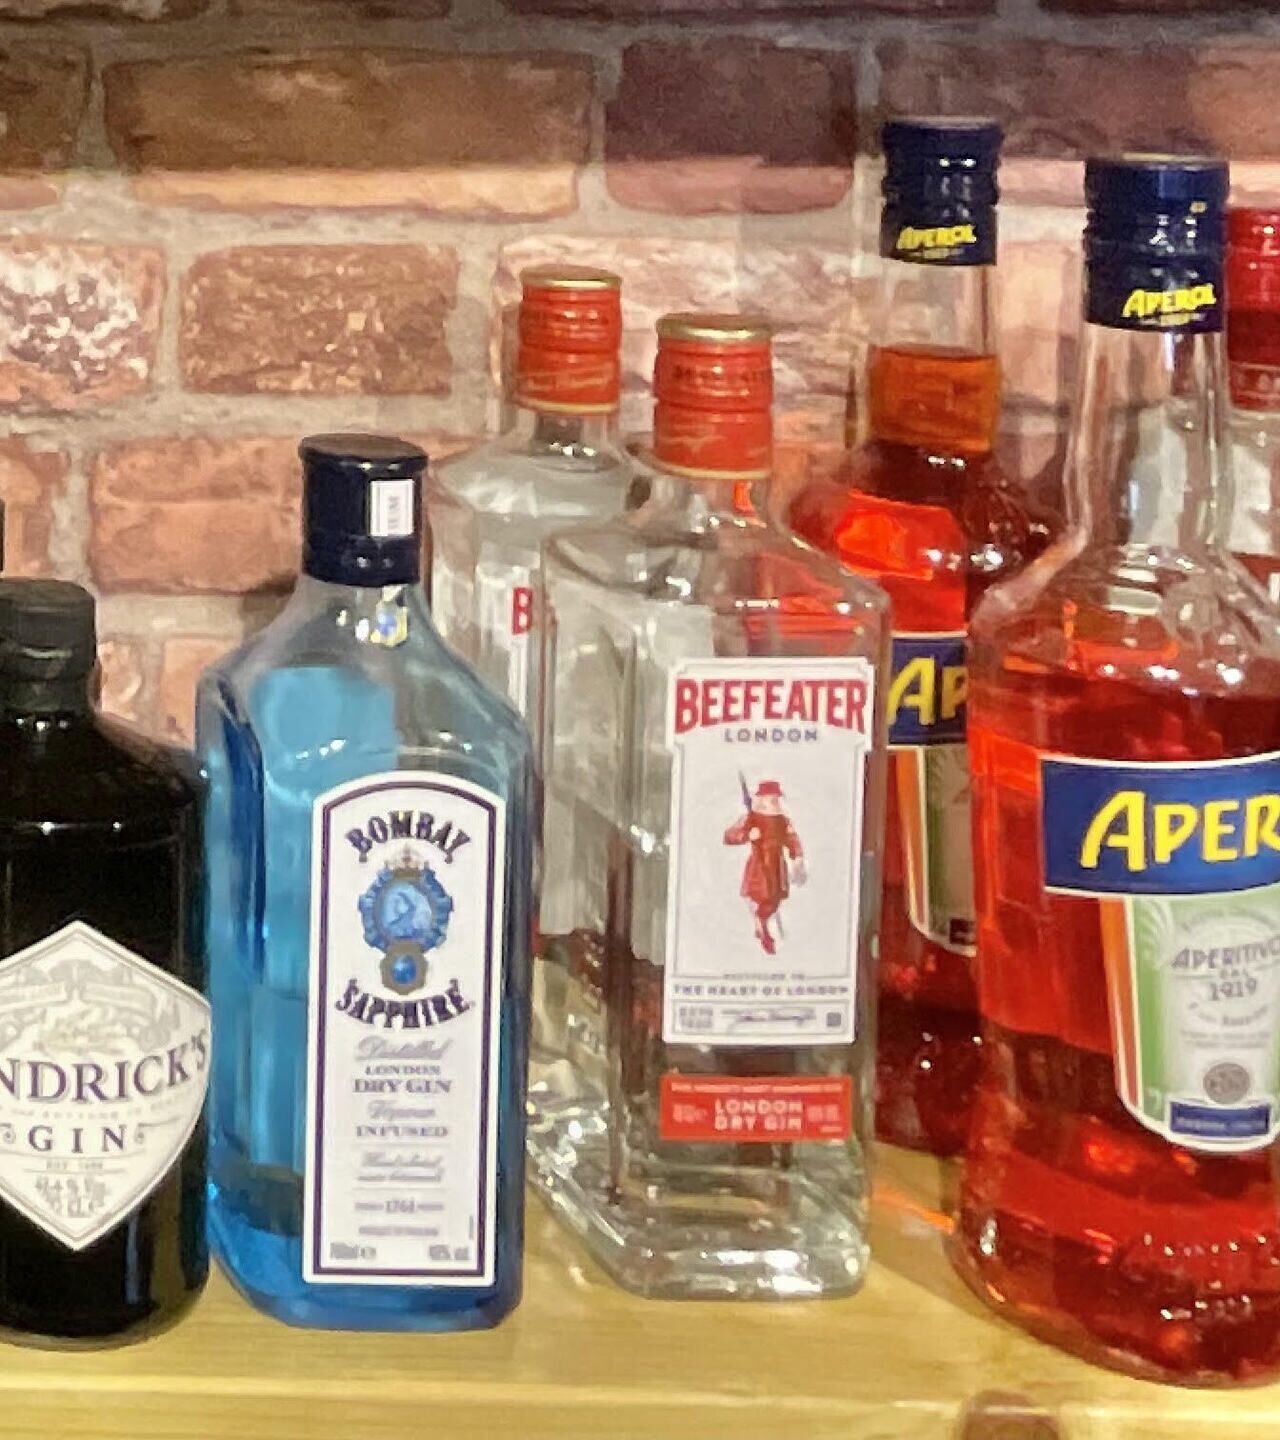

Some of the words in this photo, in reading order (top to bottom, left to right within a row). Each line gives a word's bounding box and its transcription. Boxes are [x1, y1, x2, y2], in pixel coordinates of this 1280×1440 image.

[896, 223, 978, 250] APEROL
[1121, 282, 1218, 319] APEROL
[674, 678, 868, 736] BEEFEATER
[724, 727, 819, 745] LONDON
[342, 809, 475, 864] BOMBAY
[334, 977, 474, 1031] SAPPHIRE
[353, 1078, 402, 1093] DRY
[405, 1078, 453, 1094] GIN
[714, 1097, 804, 1115] LONDON
[714, 1115, 758, 1131] DRY
[763, 1116, 803, 1131] GIN
[27, 1123, 128, 1154] GIN
